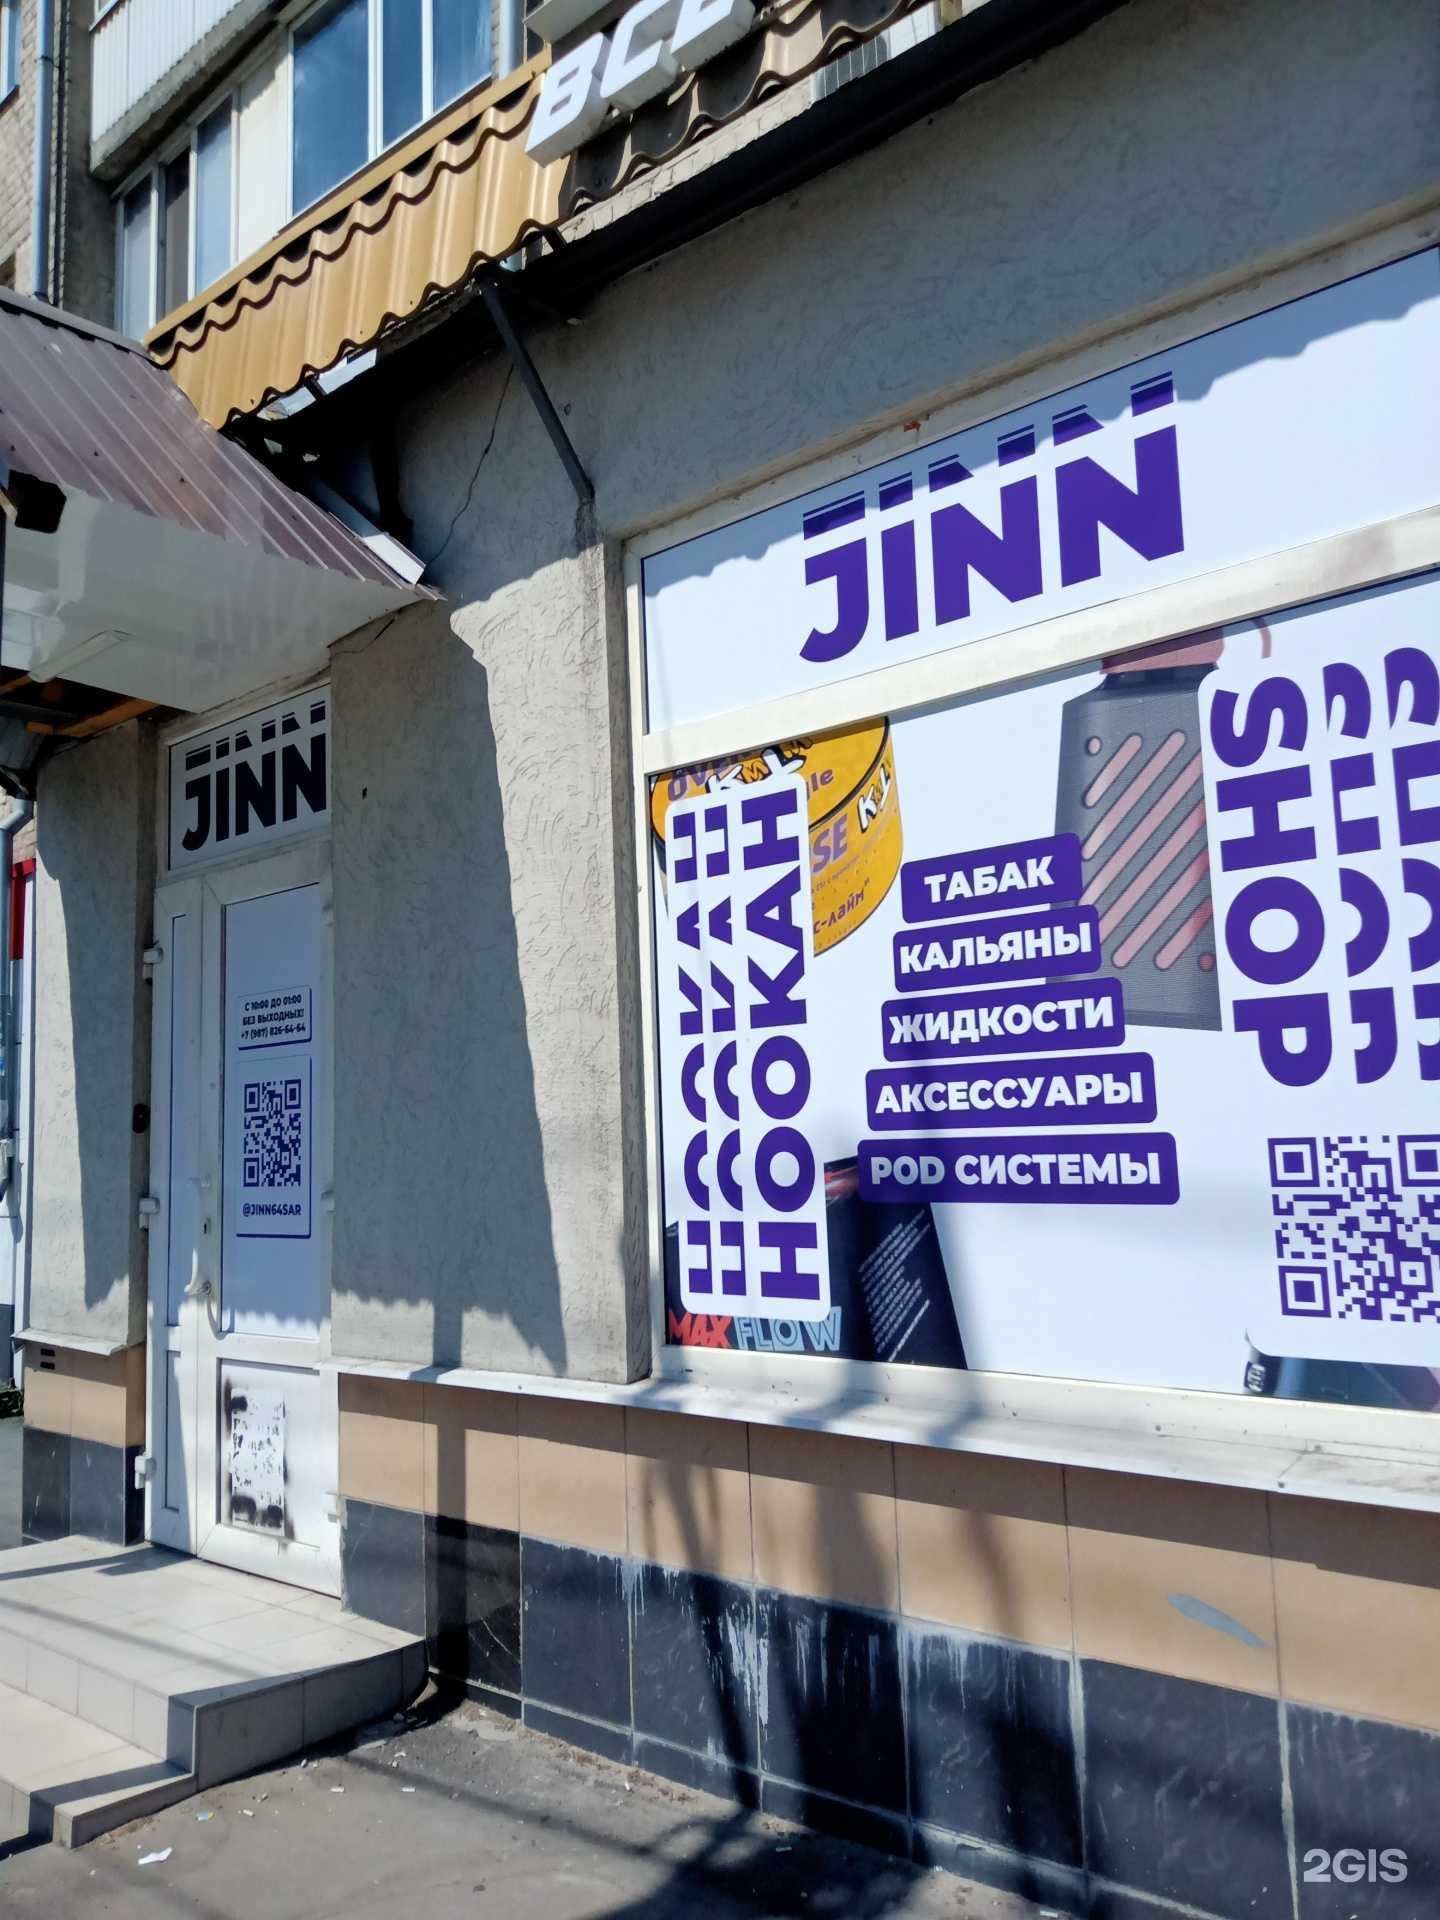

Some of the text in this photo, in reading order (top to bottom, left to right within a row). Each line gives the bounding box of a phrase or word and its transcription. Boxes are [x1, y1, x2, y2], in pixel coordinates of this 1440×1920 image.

[800, 372, 1184, 663] JINN
[181, 701, 327, 851] JINN
[924, 856, 1054, 903] ТАБАК
[1210, 677, 1333, 1087] SHOP
[900, 922, 1092, 974] КАЛЬЯНЫ
[242, 1015, 256, 1026] БЕЗ
[244, 1001, 250, 1012] С
[270, 997, 282, 1009] ДО
[889, 996, 1114, 1044] ЖИДКОСТИ
[241, 1029, 249, 1040] +7
[741, 788, 821, 1301] HOOKAH
[875, 1072, 1144, 1114] АКСЕССУАРЫ
[870, 1153, 1161, 1186] POD СИСТЕМЫ
[242, 1203, 302, 1217] @JINN64SAR
